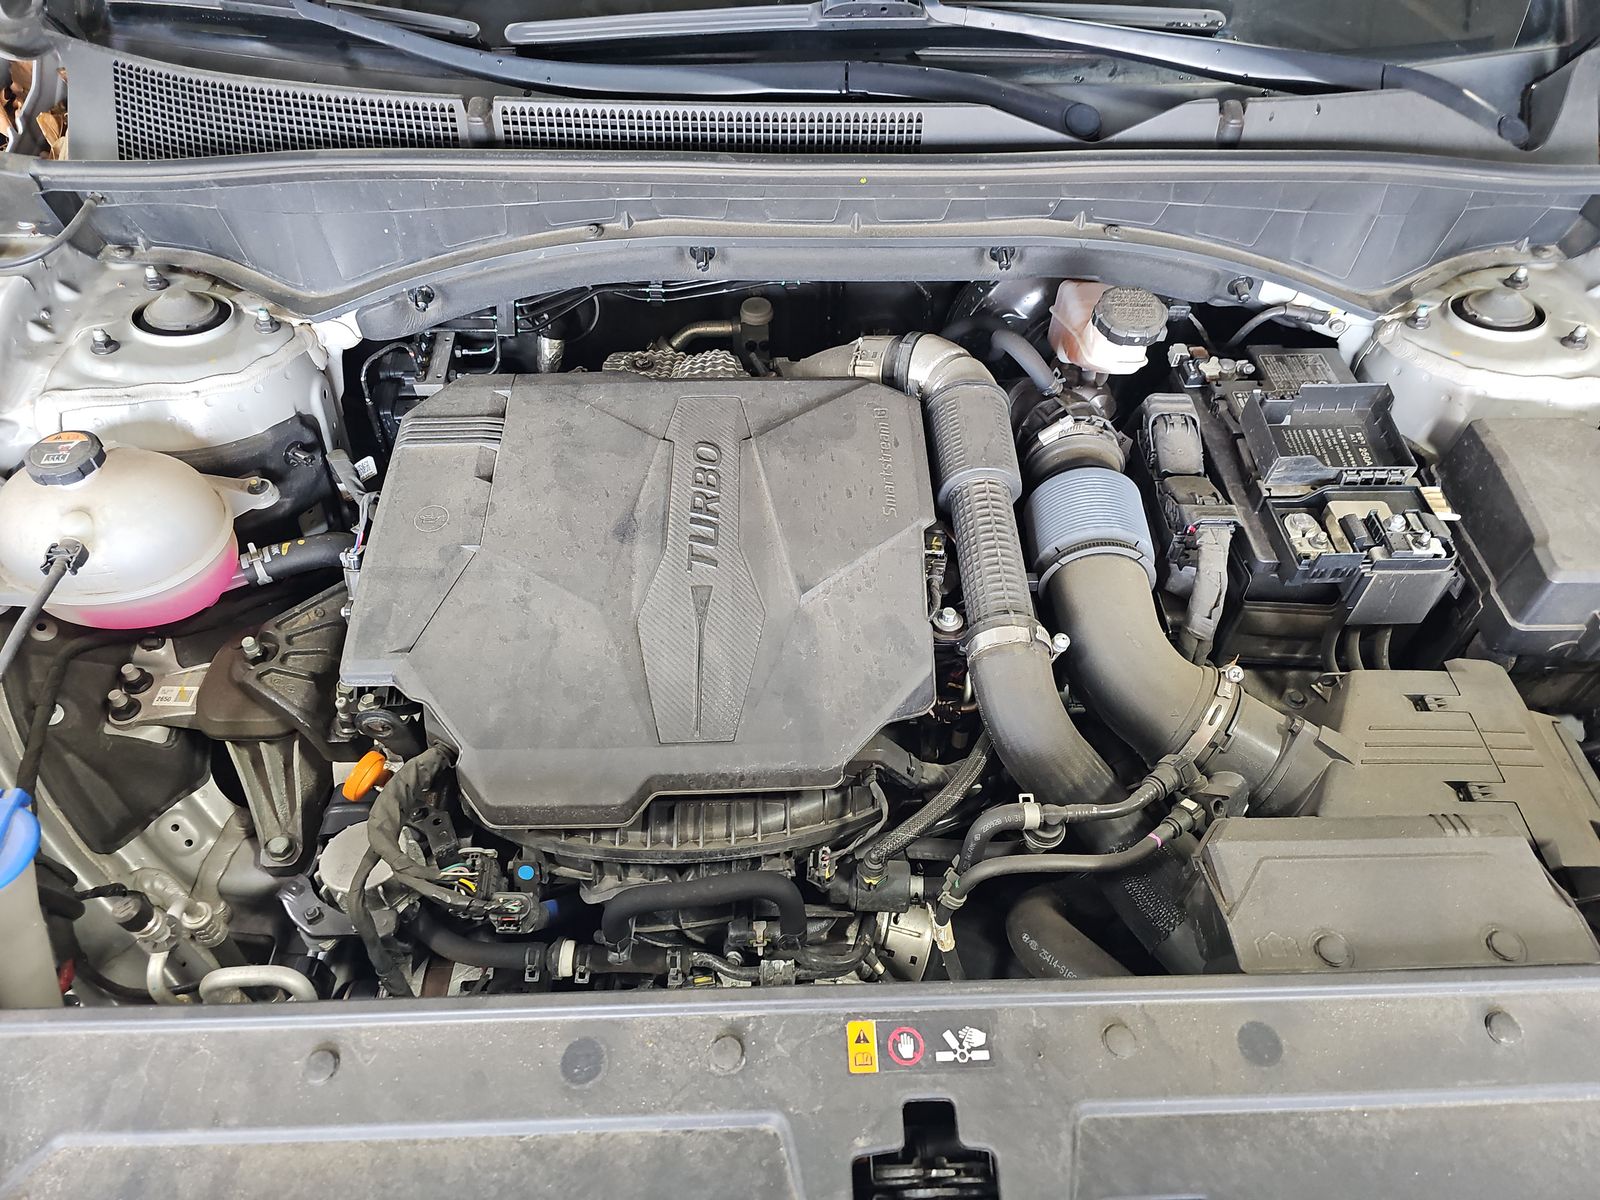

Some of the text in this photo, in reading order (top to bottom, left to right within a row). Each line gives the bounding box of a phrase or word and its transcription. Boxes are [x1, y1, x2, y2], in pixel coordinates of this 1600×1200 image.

[879, 422, 898, 518] Smartstream
[1358, 447, 1373, 466] 250A
[686, 440, 722, 574] TURBO
